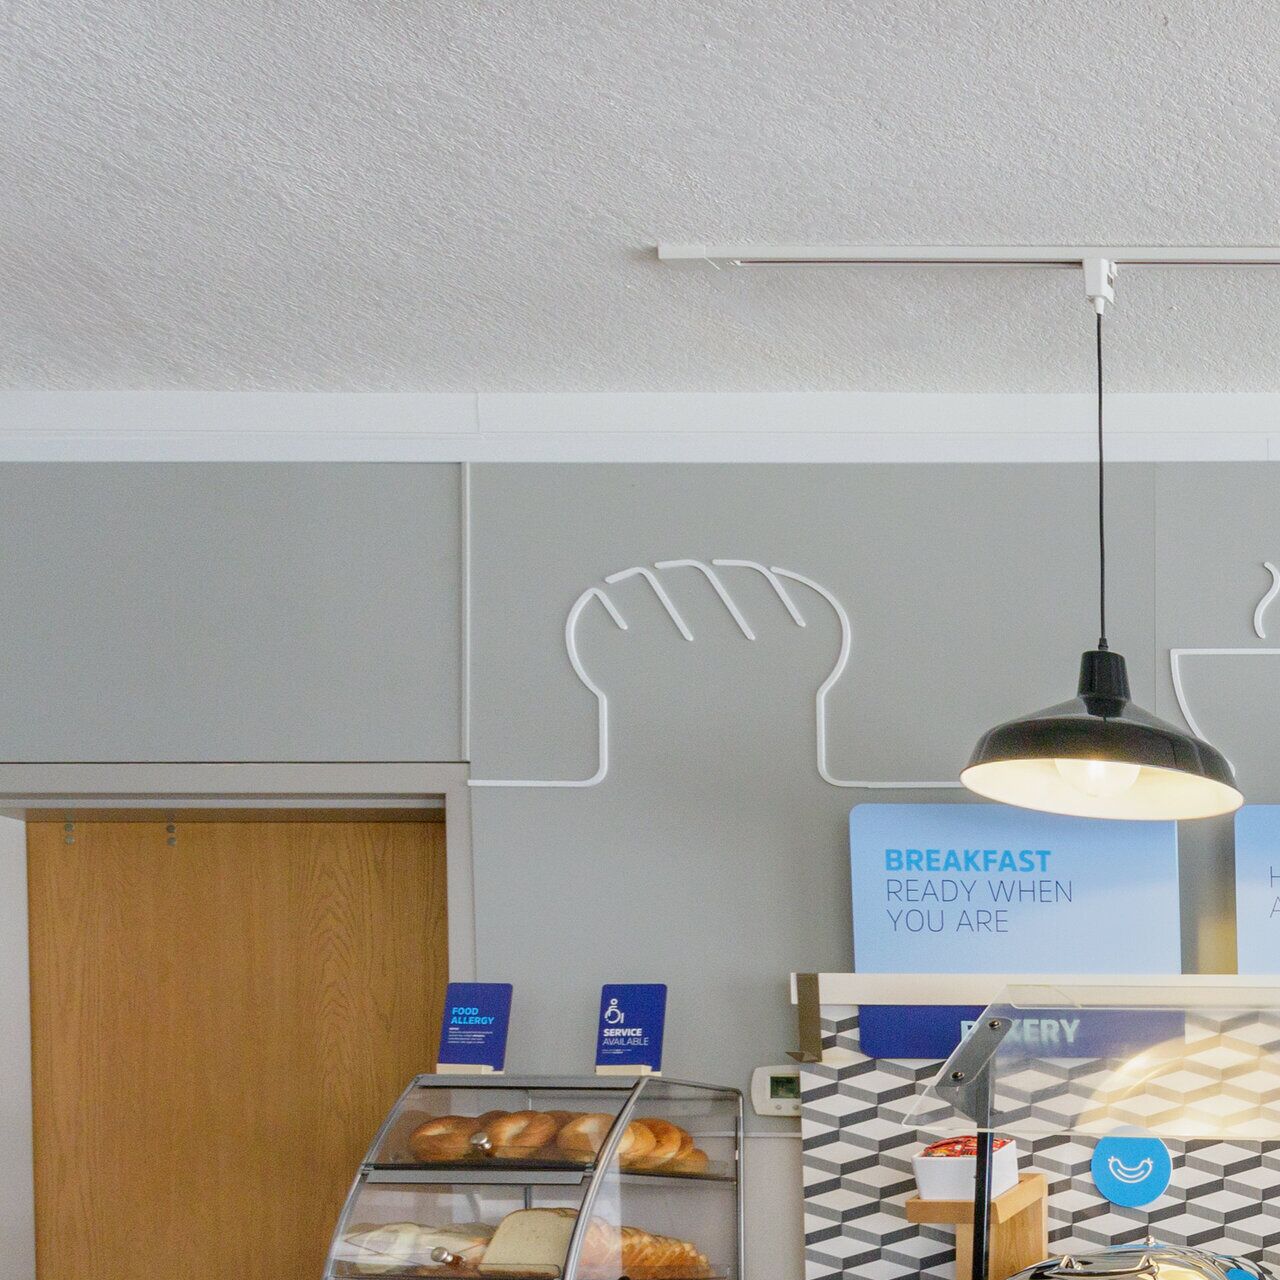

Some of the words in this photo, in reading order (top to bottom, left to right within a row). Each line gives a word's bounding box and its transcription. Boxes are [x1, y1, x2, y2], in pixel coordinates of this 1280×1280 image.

[885, 849, 1051, 872] BREAKFAST
[886, 879, 977, 902] READY
[987, 880, 1072, 903] WHEN
[886, 909, 944, 932] YOU
[956, 909, 1008, 932] ARE
[452, 1007, 479, 1016] FOOD
[450, 1016, 495, 1025] ALLERGY
[603, 1028, 642, 1037] SERVICE
[960, 1019, 1080, 1043] KERY
[602, 1037, 649, 1046] AVAILABLE
